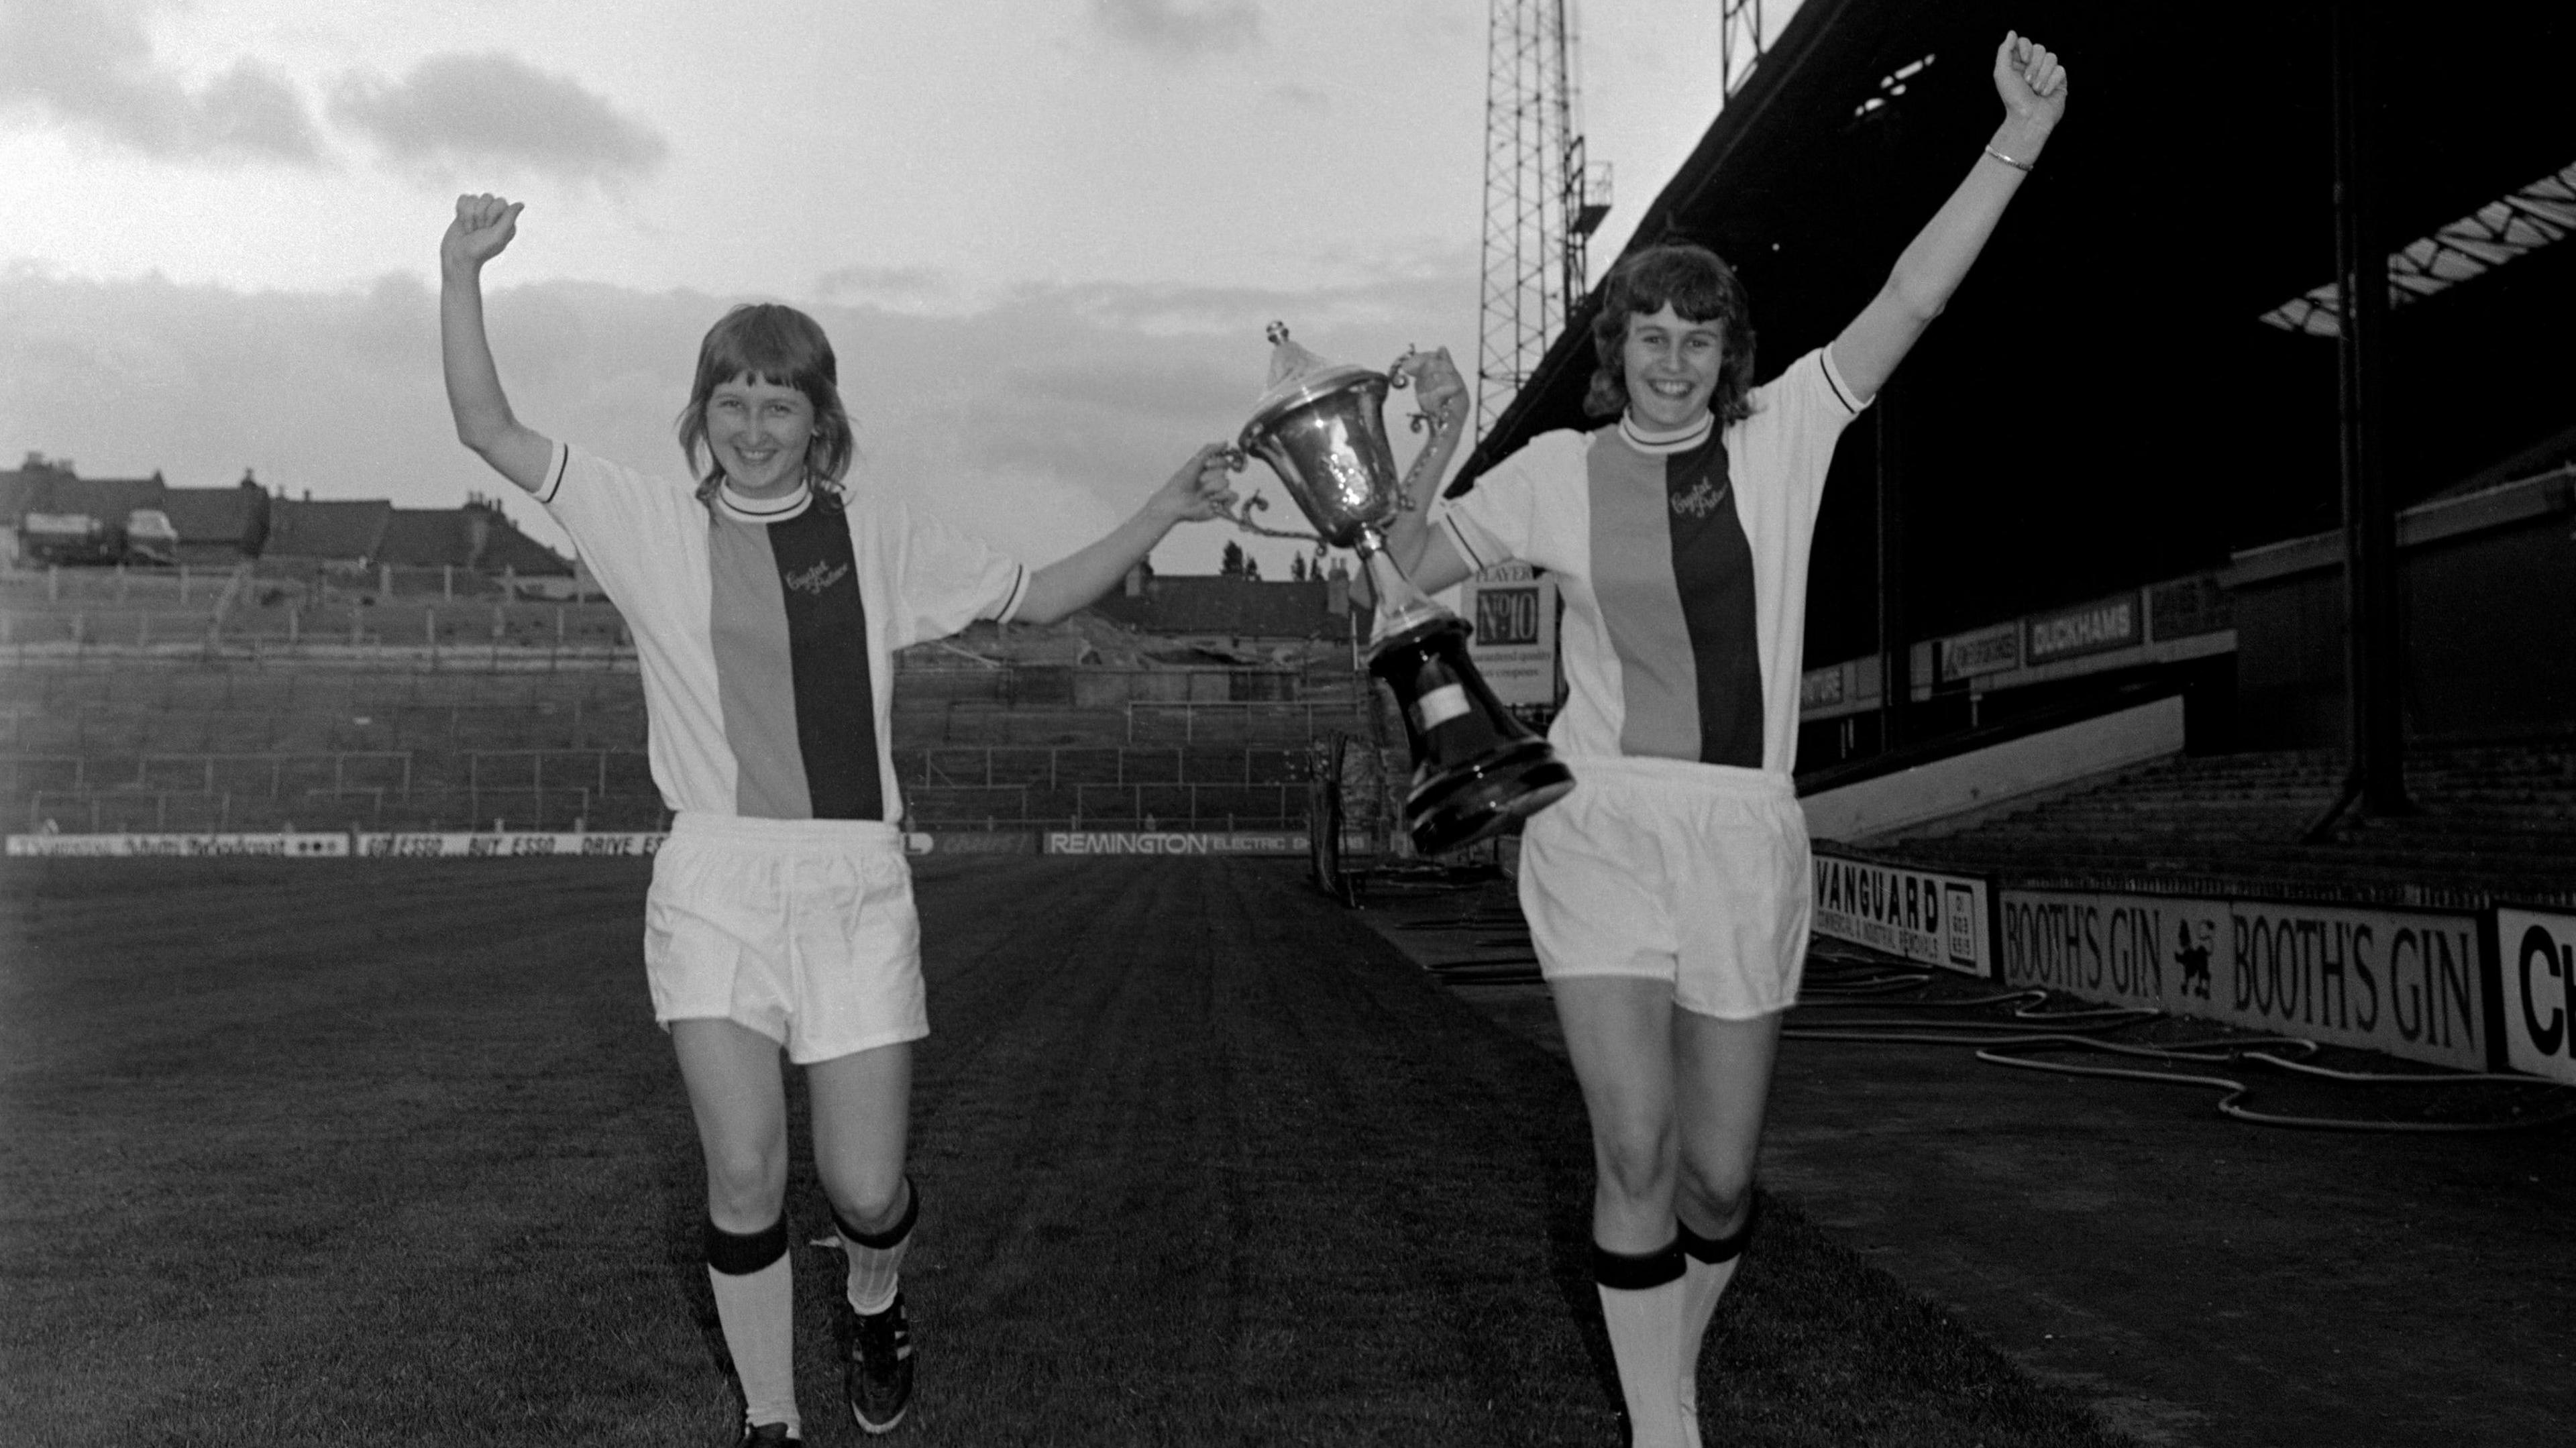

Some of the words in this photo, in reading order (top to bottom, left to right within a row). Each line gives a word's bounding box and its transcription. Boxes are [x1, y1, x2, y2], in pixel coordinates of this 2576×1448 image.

[2033, 604, 2131, 655] DUCKHAMS
[512, 837, 553, 854] ESSO
[1051, 833, 1207, 854] REMINGTON
[1213, 837, 1285, 850] ELECTRIC
[1817, 859, 1938, 934] VANGUARD
[1898, 928, 1939, 960] REMOVALS
[2110, 907, 2161, 1001] GIN
[2391, 928, 2475, 1052] GIN
